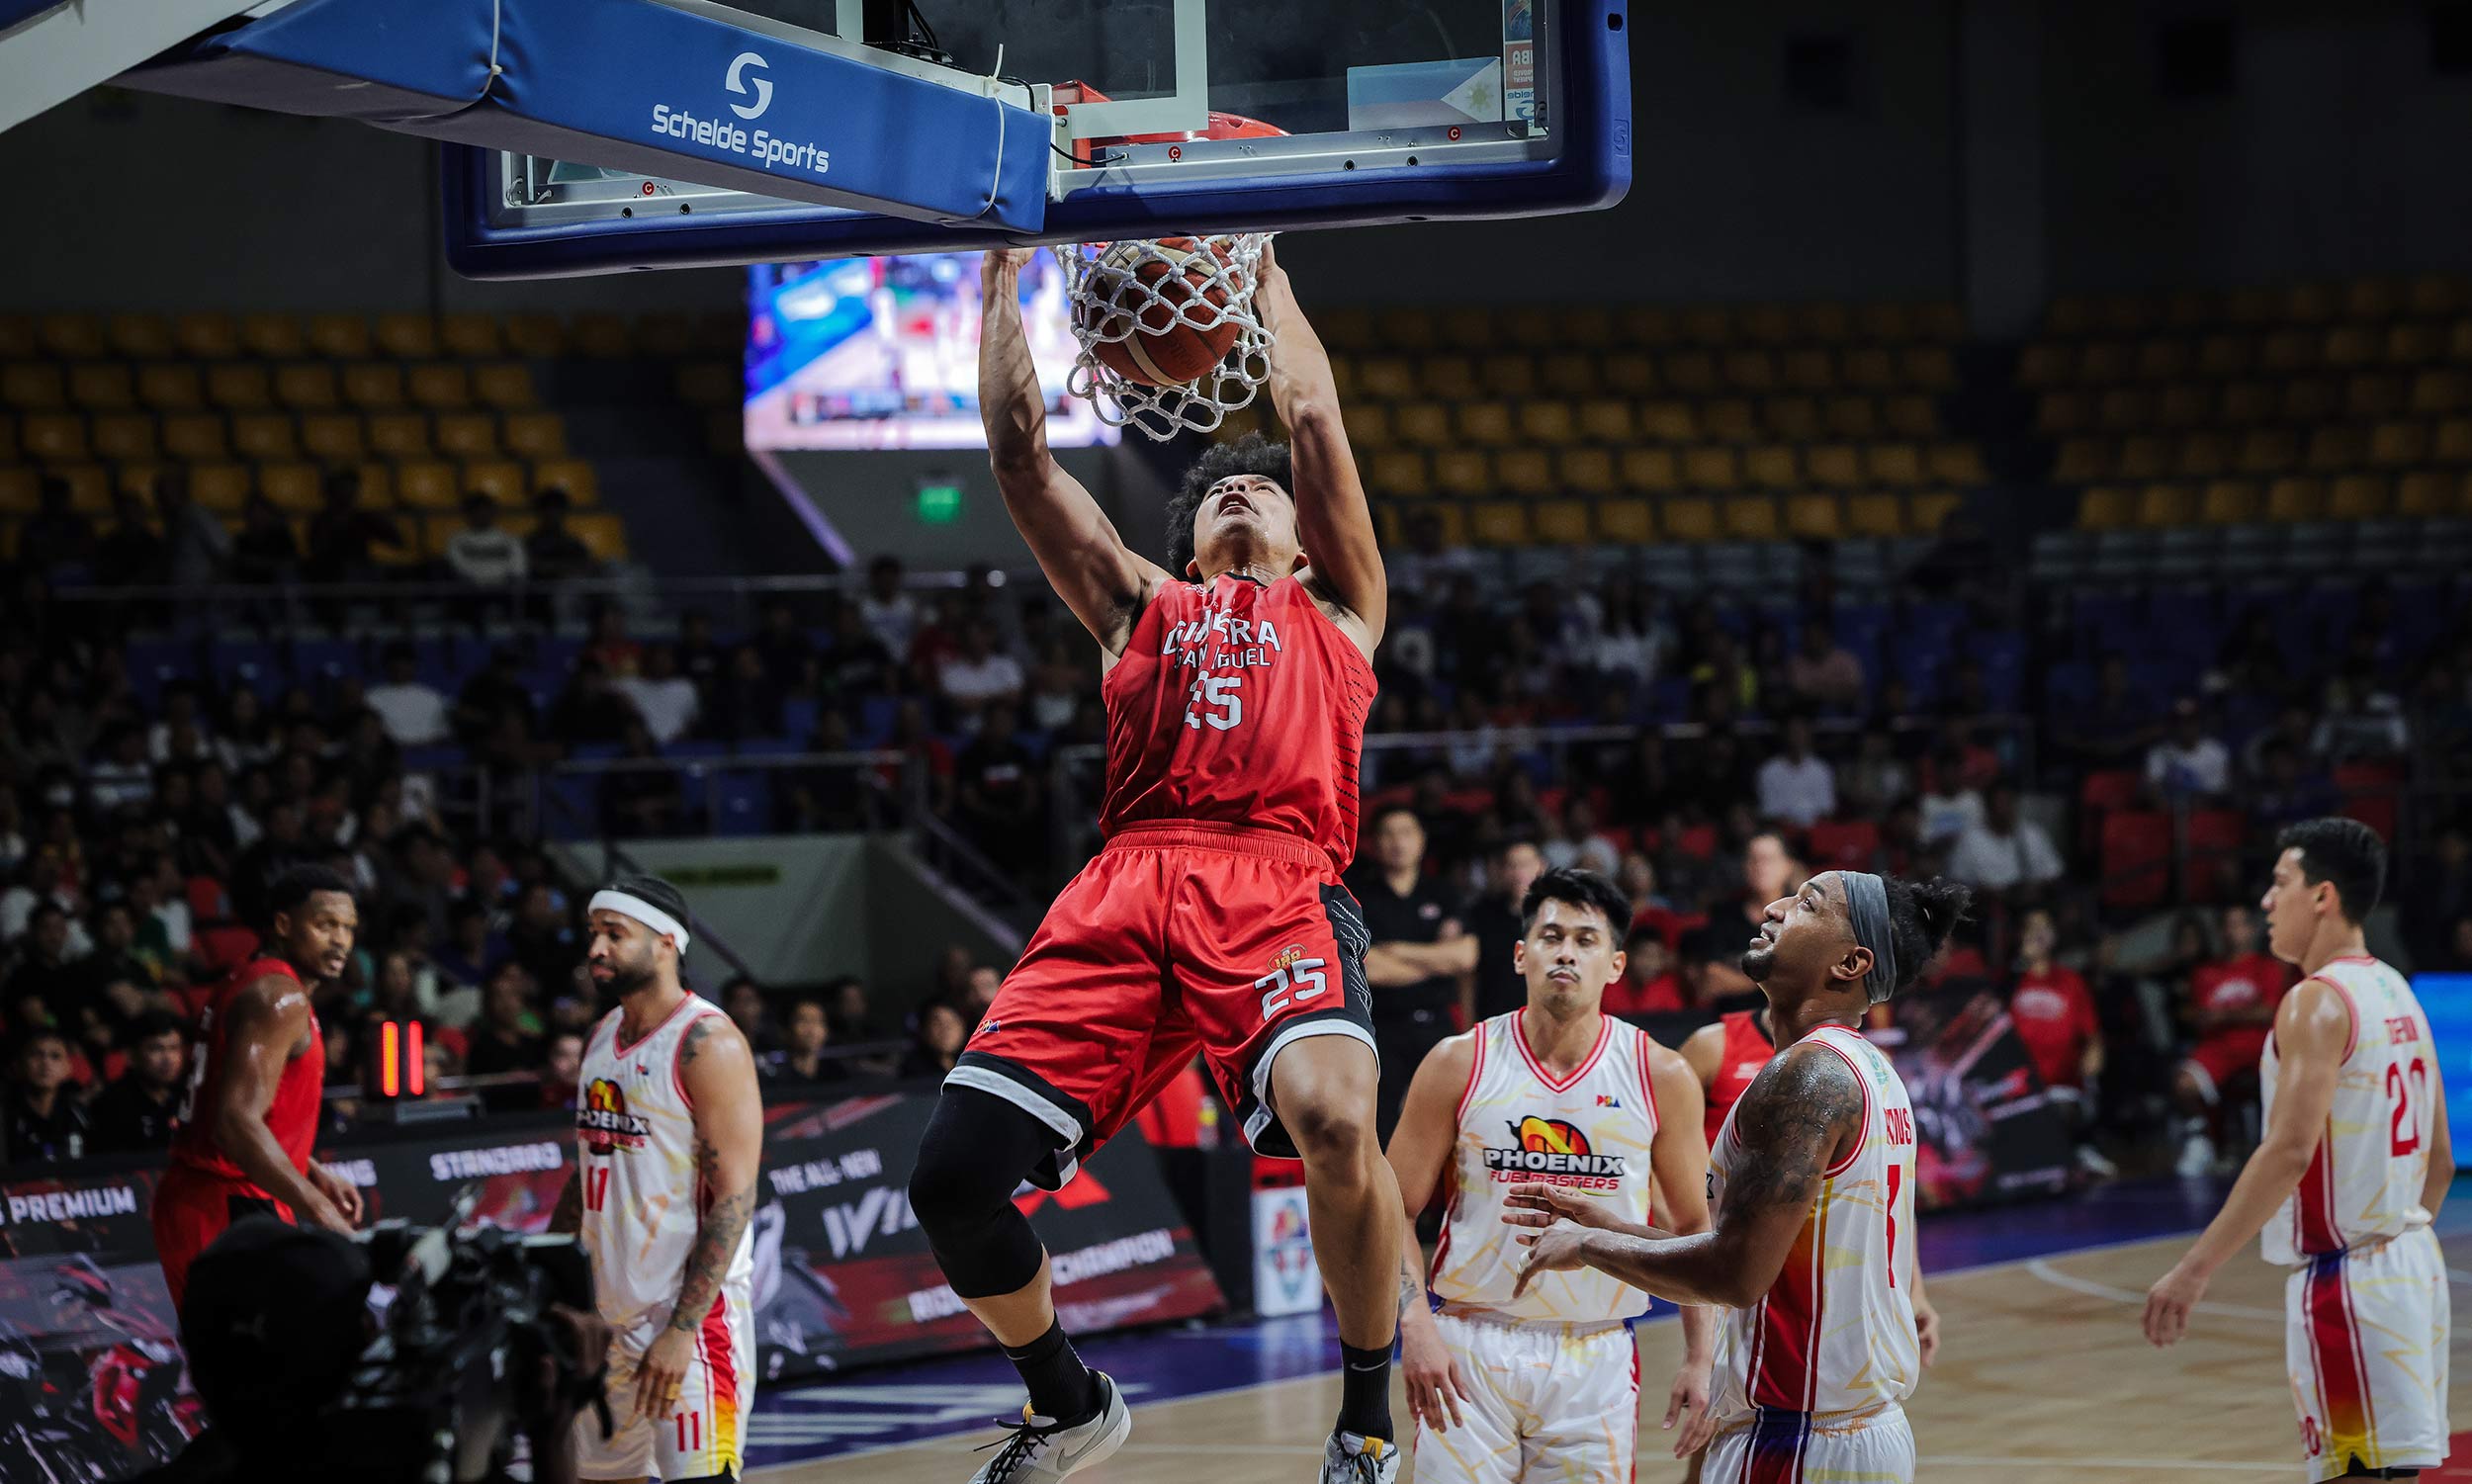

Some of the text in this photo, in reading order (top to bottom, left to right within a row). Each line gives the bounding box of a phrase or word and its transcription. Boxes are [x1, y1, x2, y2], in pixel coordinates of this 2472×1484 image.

[651, 103, 830, 174] Schelde Sports
[1183, 669, 1243, 732] 25
[1253, 957, 1327, 1022] 25
[1596, 1094, 1622, 1108] PBA
[1483, 1147, 1625, 1178] PHOENIX
[8, 1185, 137, 1225] PREMIUM
[674, 1410, 701, 1452] 11
